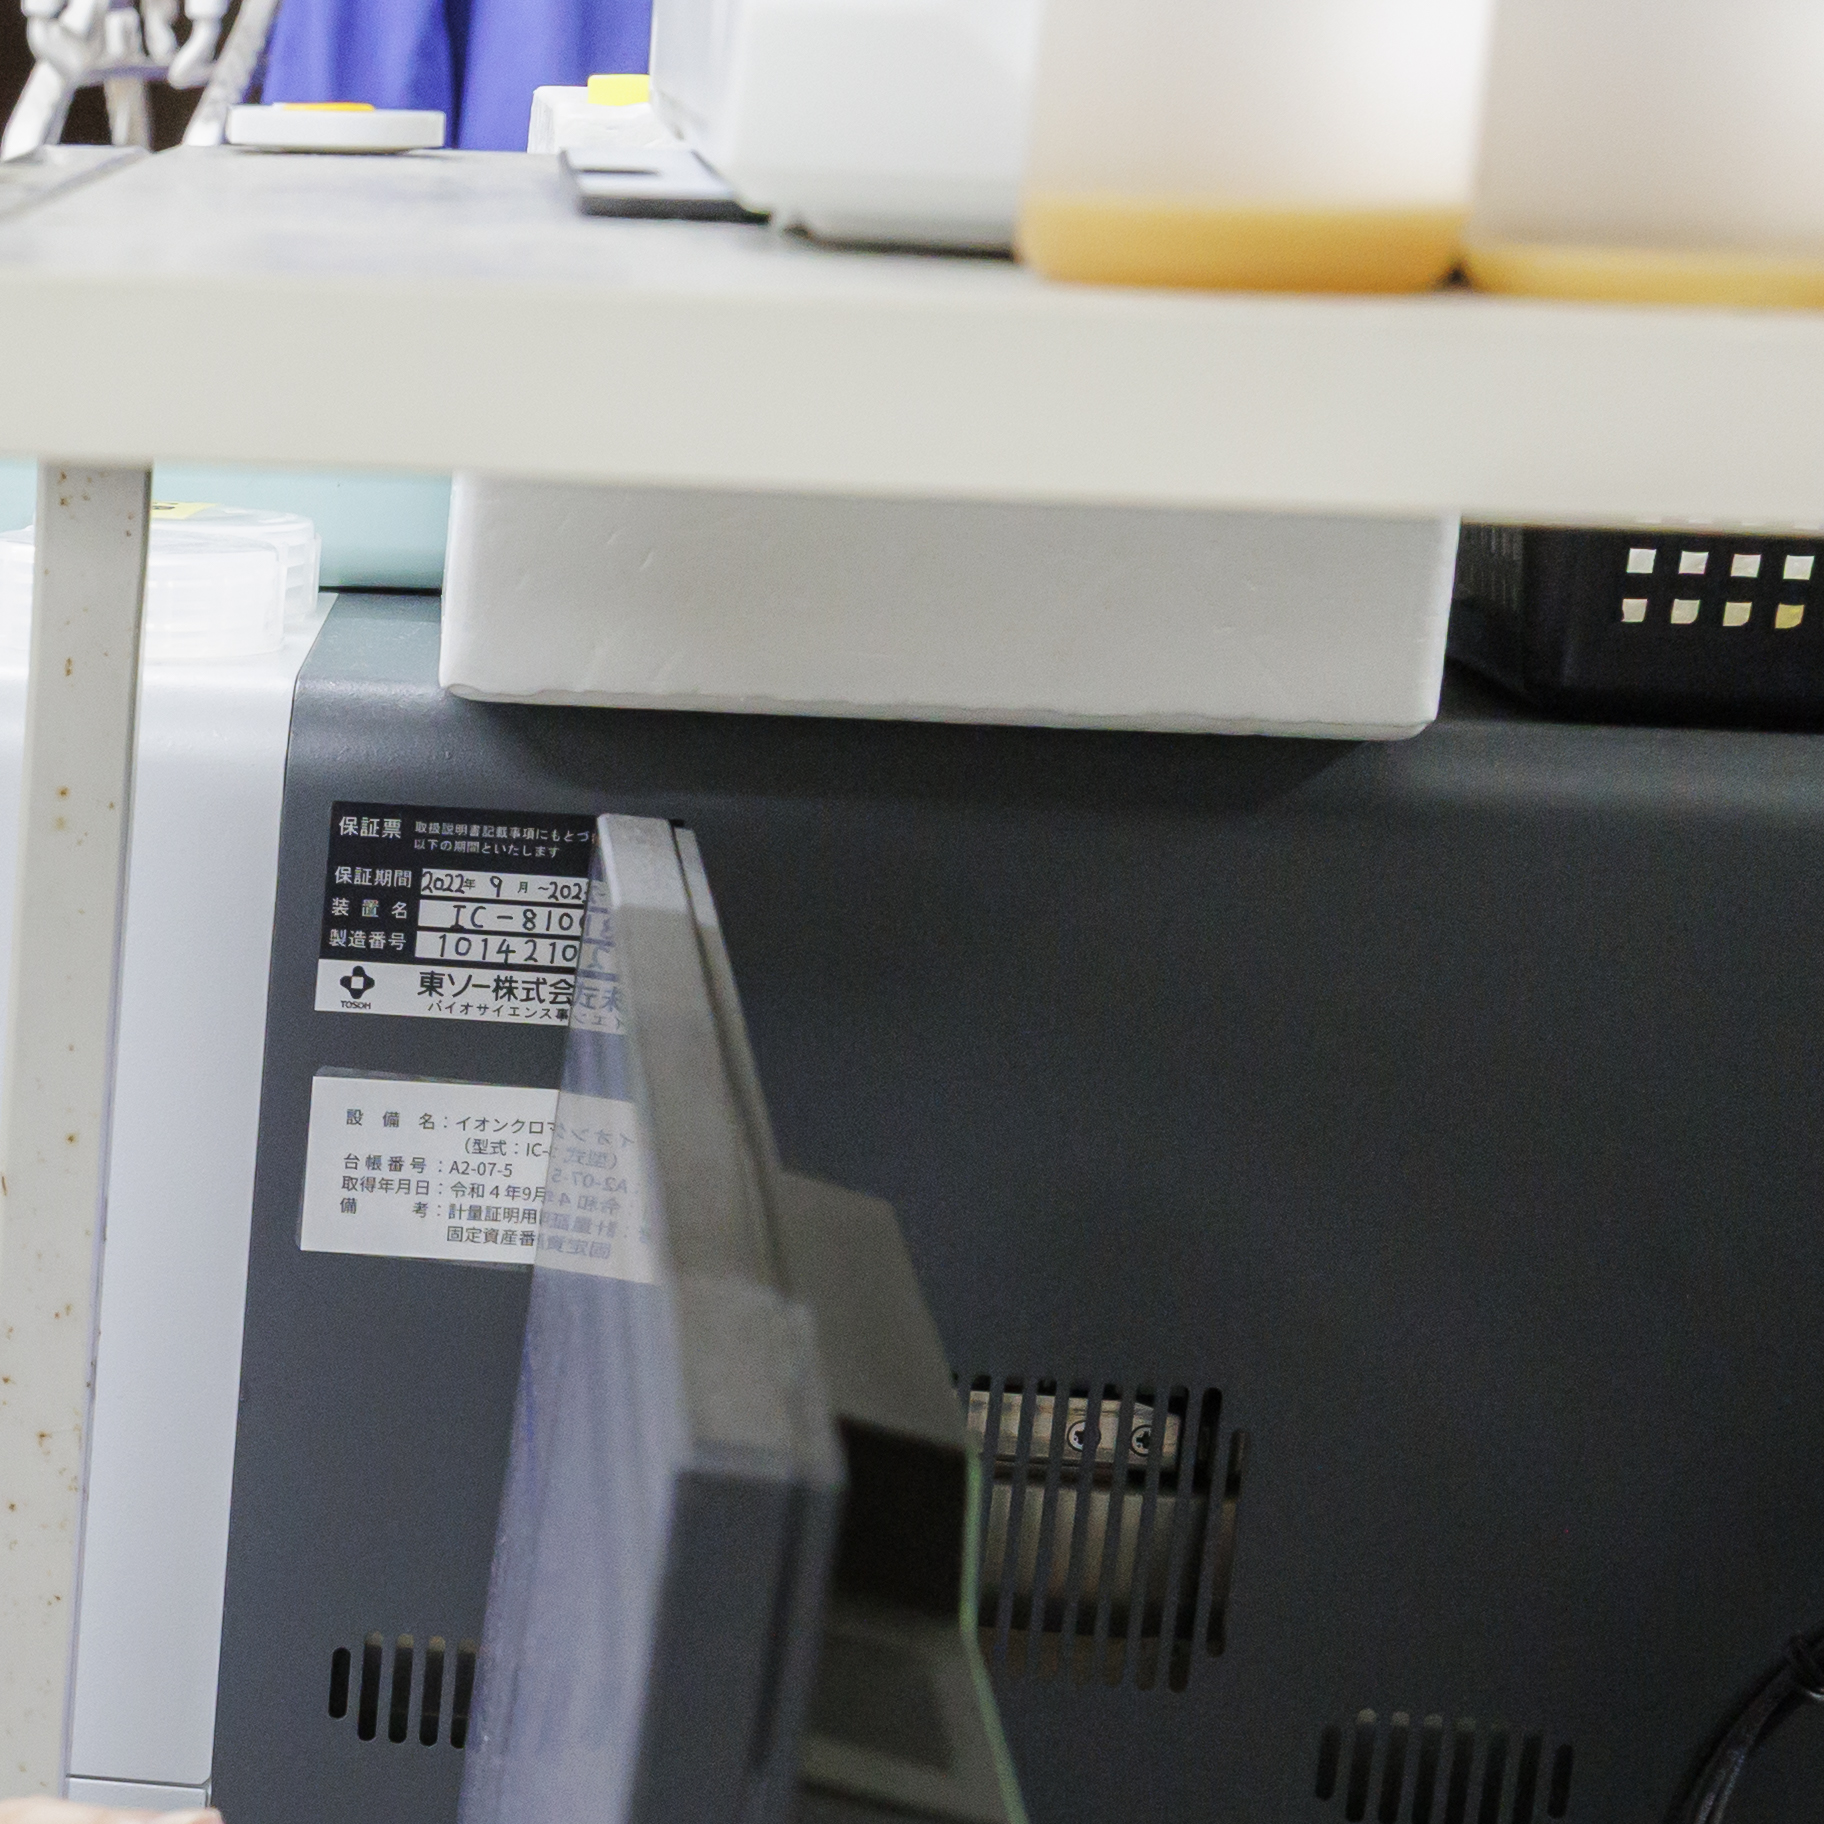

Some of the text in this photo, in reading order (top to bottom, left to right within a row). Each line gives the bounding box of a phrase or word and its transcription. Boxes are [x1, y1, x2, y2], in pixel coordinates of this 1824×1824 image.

[338, 816, 598, 844] 保証票 取扱説明書記載事項にもとづ
[414, 838, 560, 858] 以下の期間といたします
[334, 865, 412, 888] 保証期間
[449, 904, 584, 931] IC-810
[329, 928, 407, 950] 製造番号
[417, 970, 576, 1006] 東ソー株式会
[341, 1000, 372, 1011] TOSOH
